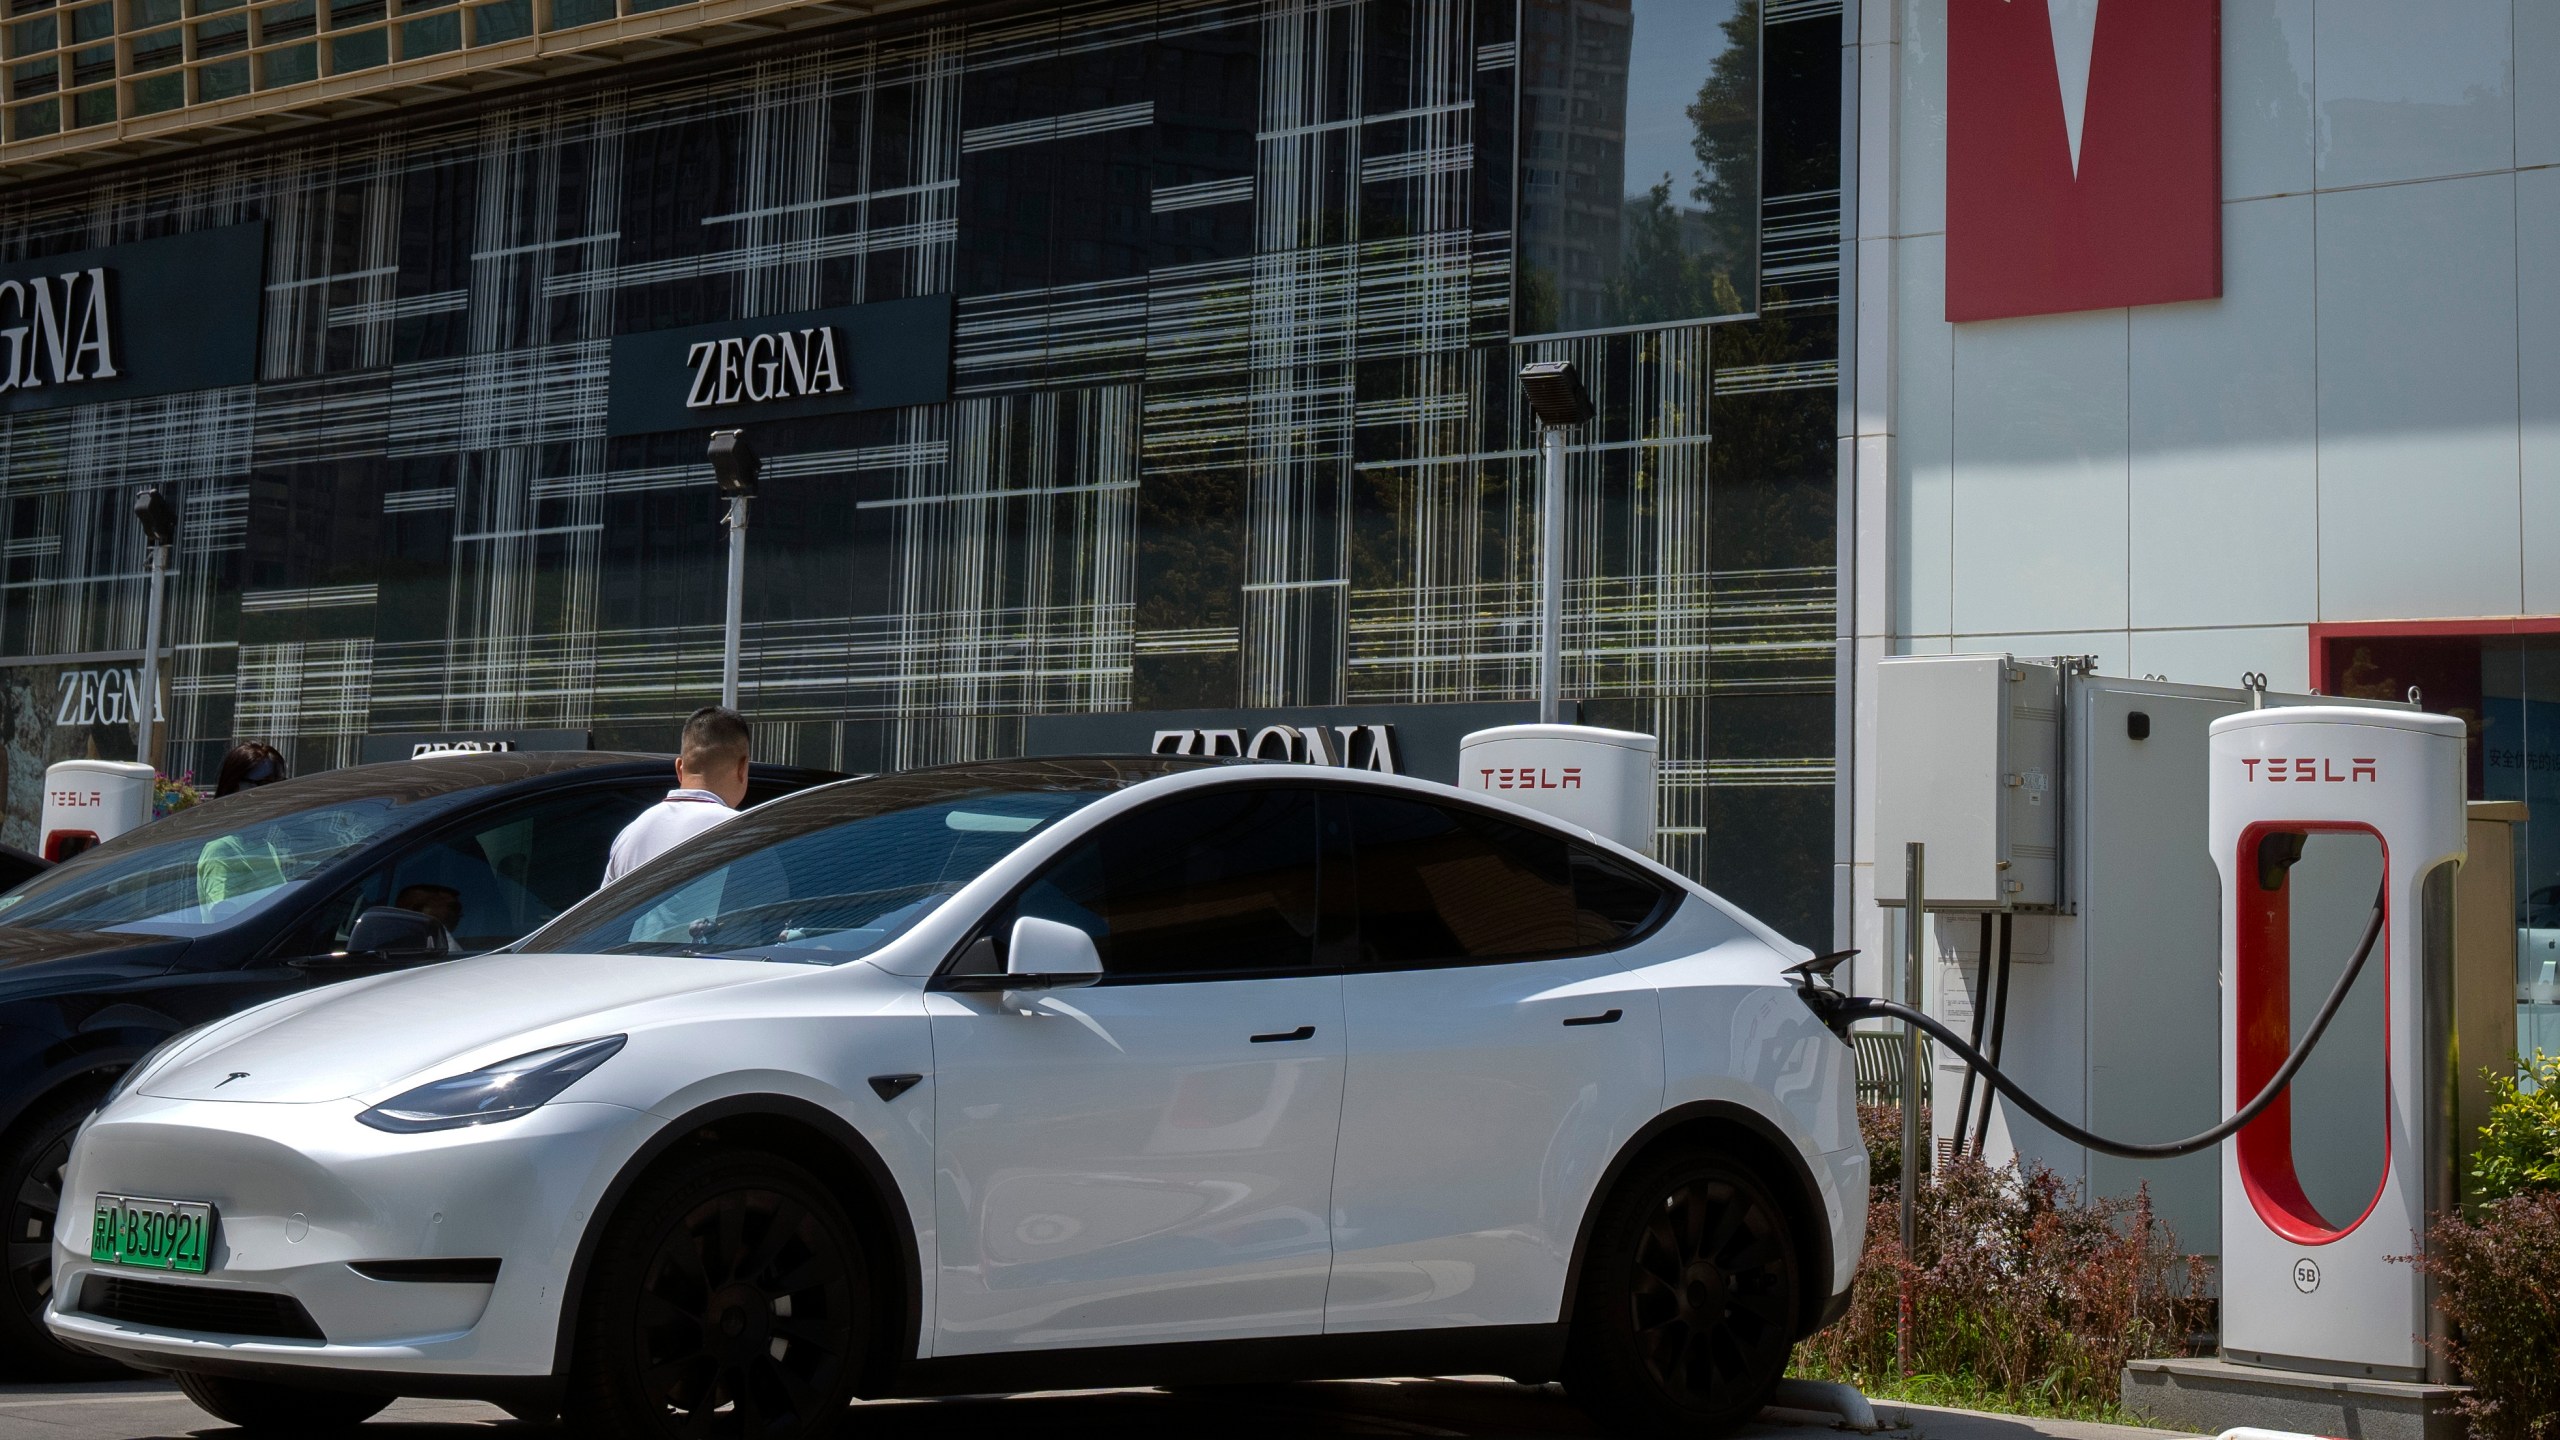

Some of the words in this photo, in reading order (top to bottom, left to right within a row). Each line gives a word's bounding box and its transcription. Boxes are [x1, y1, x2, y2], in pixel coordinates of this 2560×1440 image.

[686, 326, 844, 408] ZEGNA
[1480, 768, 1582, 789] TESLA
[2241, 758, 2377, 782] TESLA
[51, 791, 101, 807] TESLA
[2297, 1267, 2316, 1283] 5B
